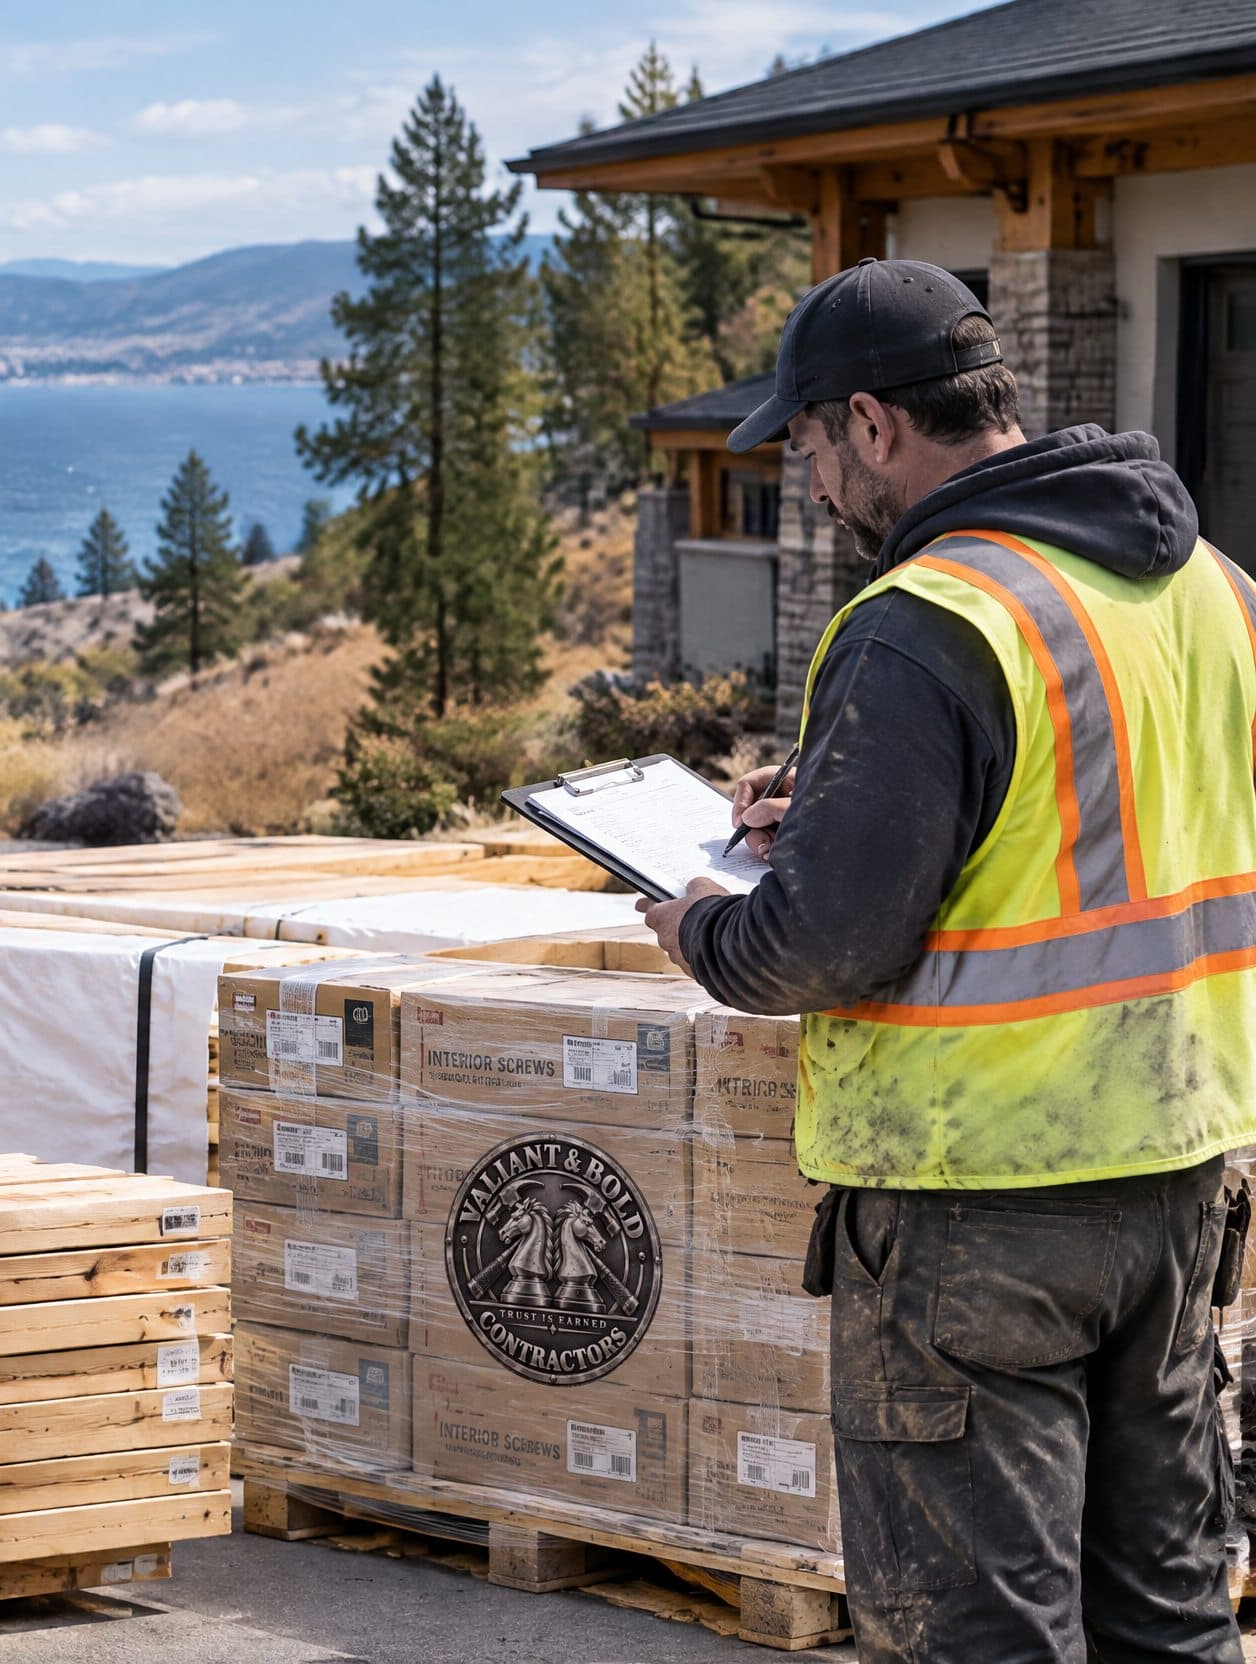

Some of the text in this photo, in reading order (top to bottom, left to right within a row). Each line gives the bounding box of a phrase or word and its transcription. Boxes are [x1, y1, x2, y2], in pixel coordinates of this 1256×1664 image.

[497, 1057, 555, 1077] SCREWS
[459, 1144, 644, 1239] VALIANT & BOLD
[500, 1309, 607, 1328] TRUST IS EARNED
[479, 1311, 627, 1372] CONTRACTORS
